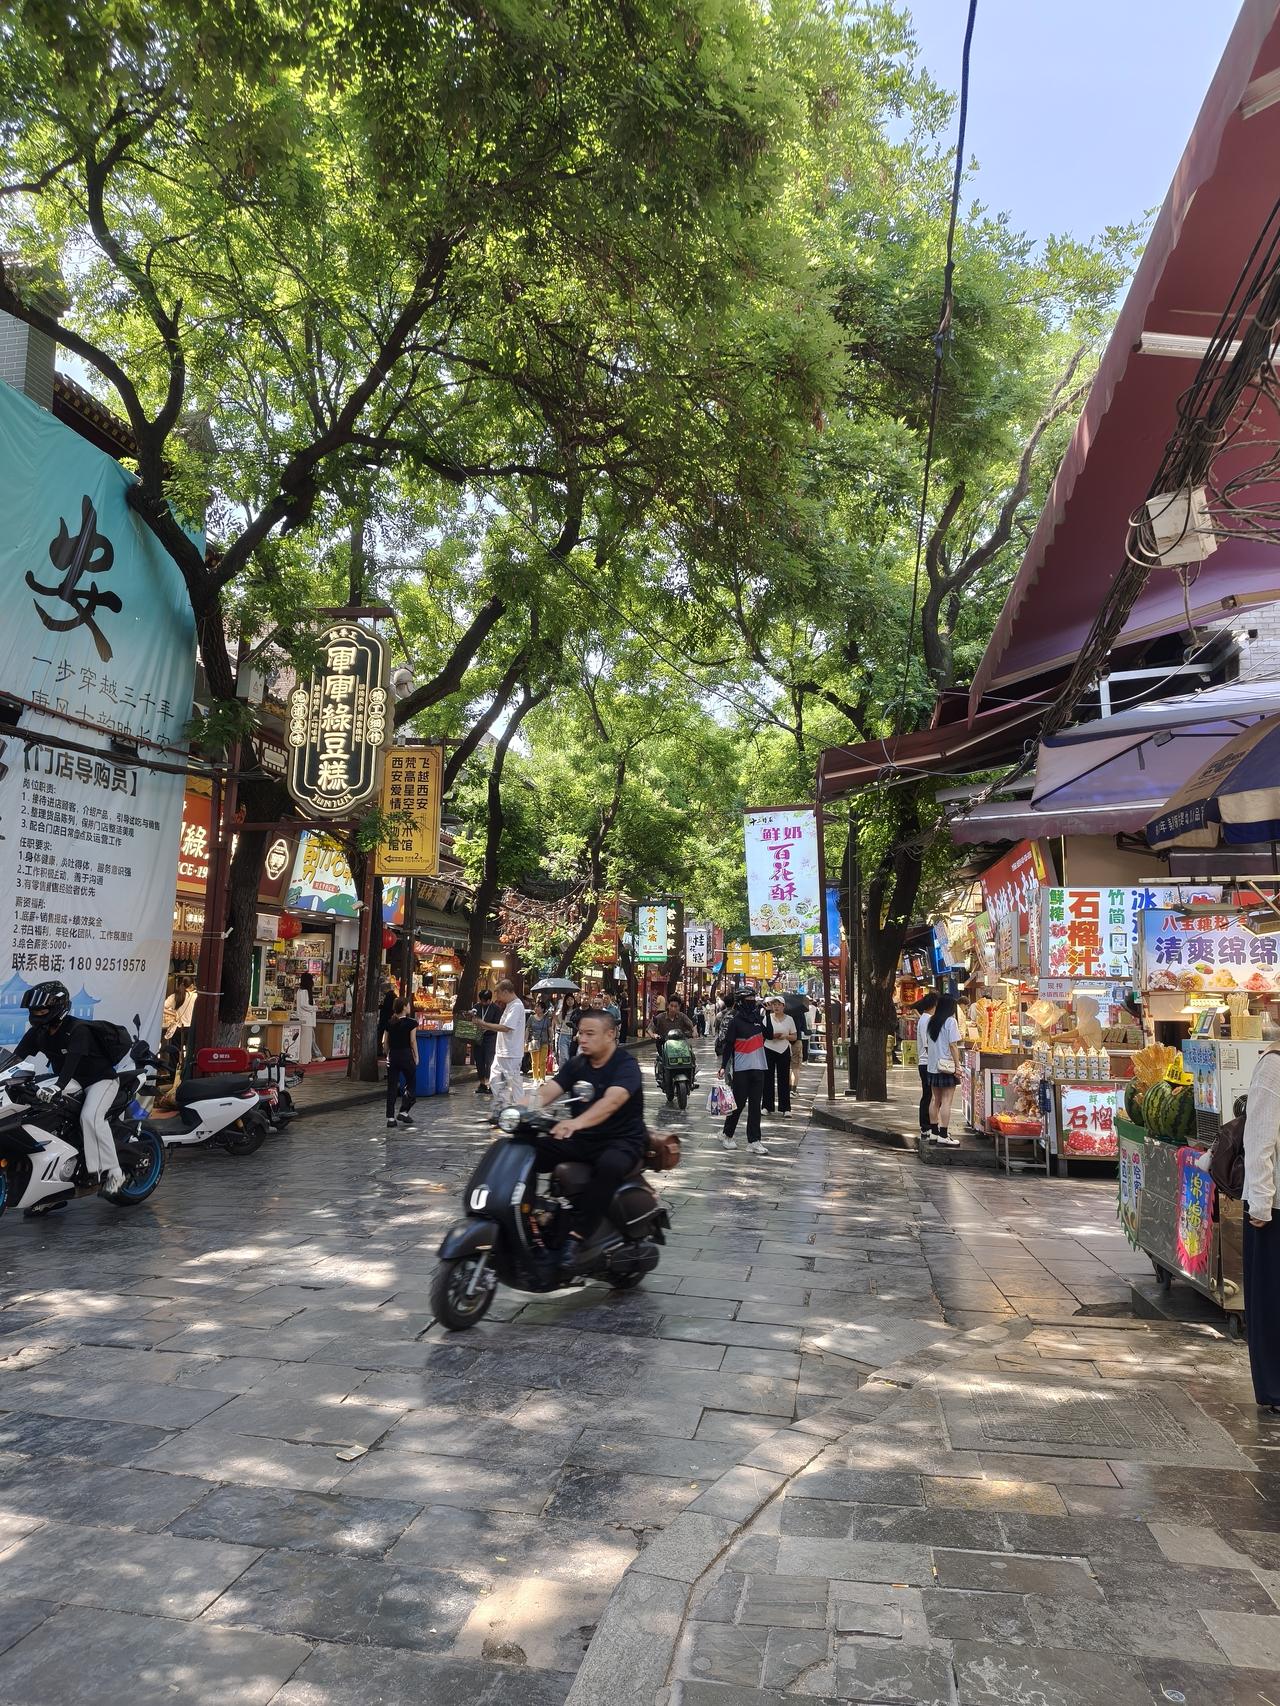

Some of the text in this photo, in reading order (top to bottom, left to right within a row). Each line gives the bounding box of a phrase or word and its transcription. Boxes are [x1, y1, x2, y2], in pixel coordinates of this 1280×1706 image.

[32, 656, 174, 723] 一步穿越三千年
[417, 757, 430, 810] 飞越西安
[389, 757, 403, 851] 西安爱情物馆
[761, 826, 802, 841] 鲜奶
[768, 843, 798, 901] 百花酥
[1049, 889, 1065, 921] 鲜榨
[1107, 889, 1126, 924] 竹筒
[1068, 891, 1101, 976] 石榴汁
[1154, 936, 1278, 965] 清爽绵绵
[69, 957, 92, 970] 180
[95, 957, 147, 972] 92519578
[1066, 1105, 1112, 1131] 石榴
